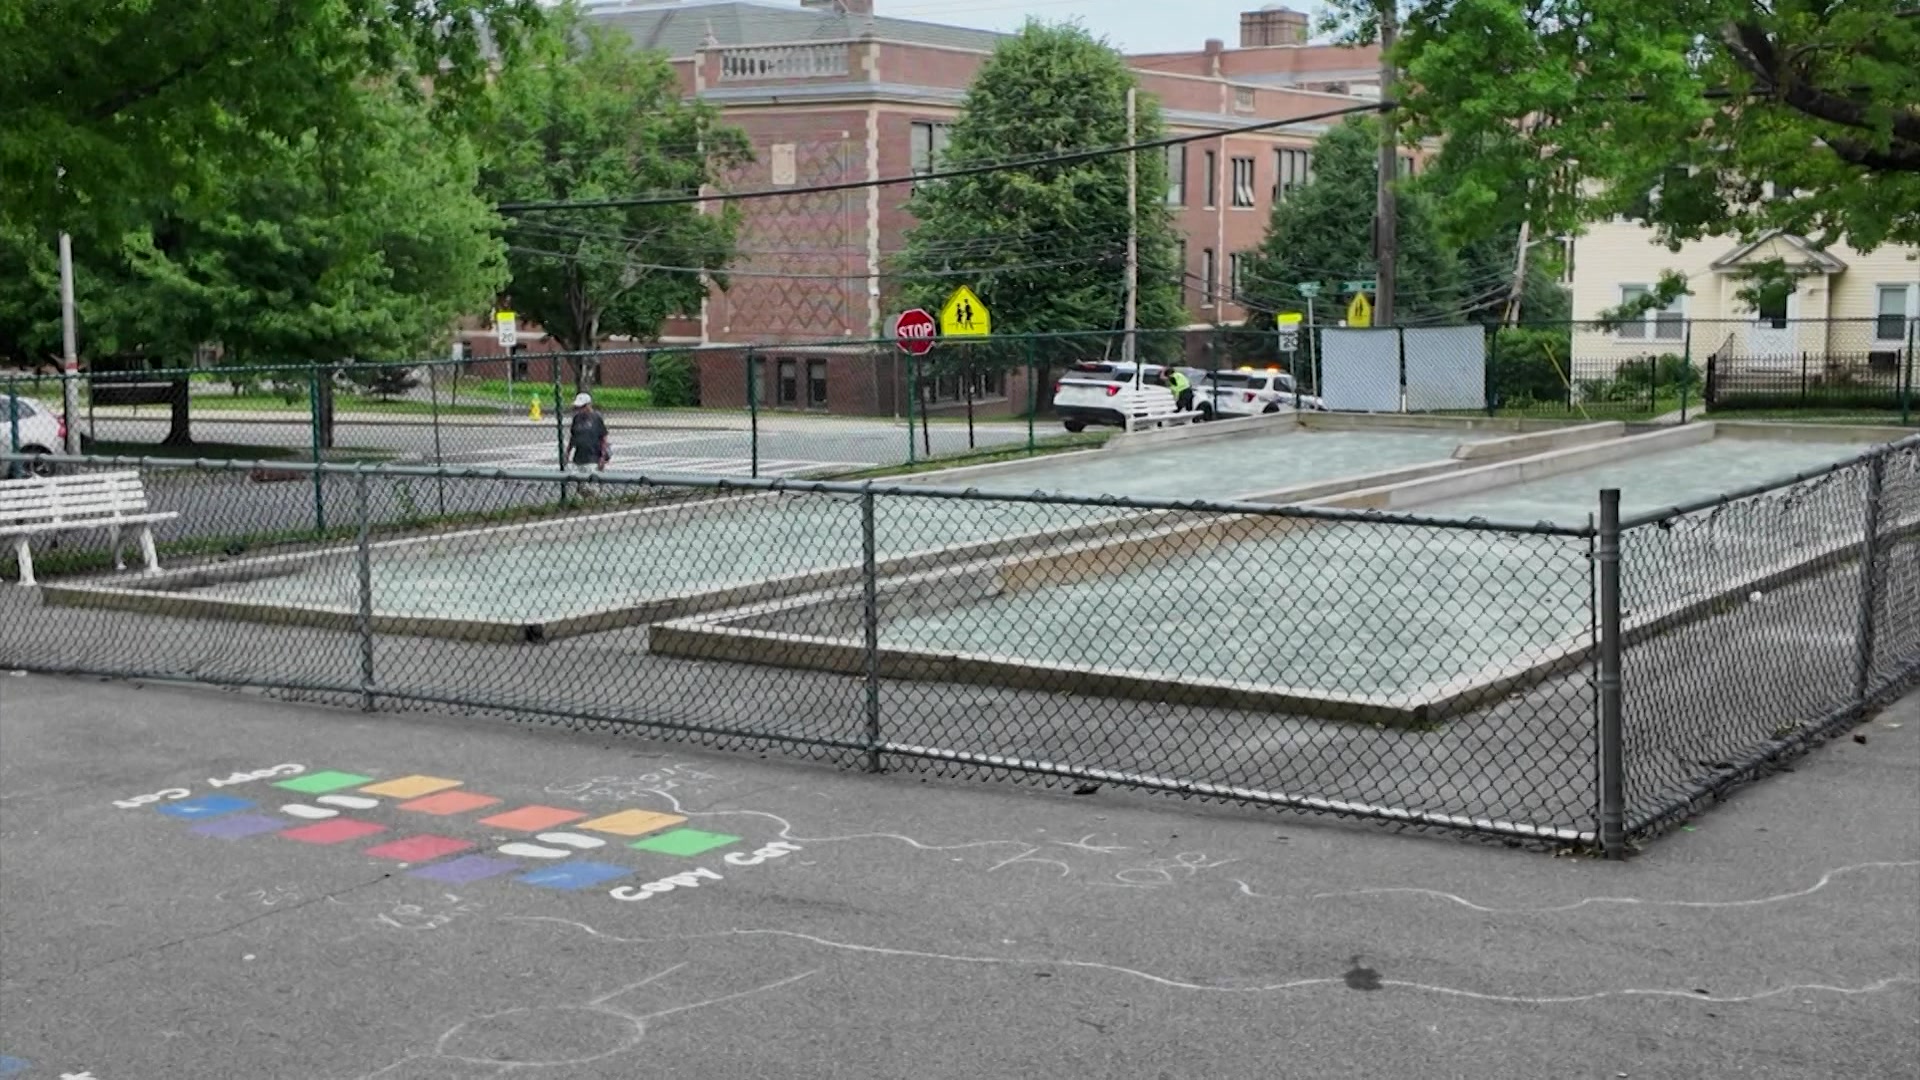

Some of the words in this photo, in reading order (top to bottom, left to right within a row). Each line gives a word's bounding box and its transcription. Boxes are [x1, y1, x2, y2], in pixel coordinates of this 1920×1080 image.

[899, 322, 932, 339] STOP
[207, 763, 305, 788] Copy
[609, 866, 725, 902] Copy
[724, 841, 803, 866] Cat
